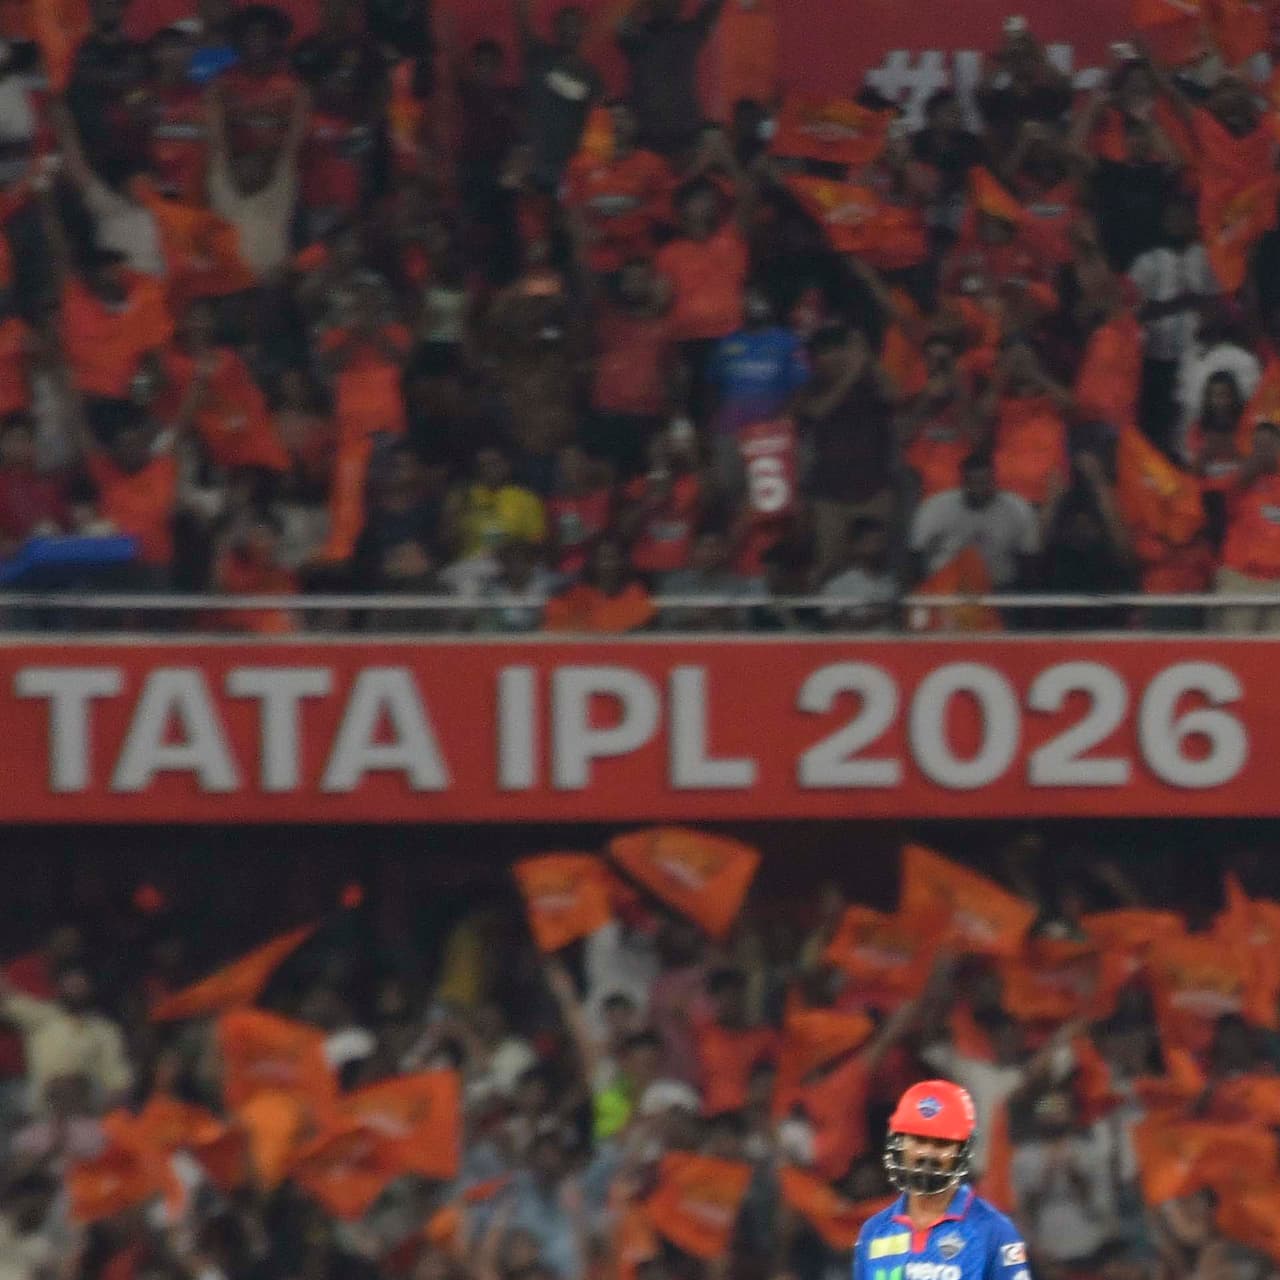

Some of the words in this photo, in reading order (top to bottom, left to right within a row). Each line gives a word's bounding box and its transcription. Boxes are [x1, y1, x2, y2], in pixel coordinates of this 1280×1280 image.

[14, 664, 452, 793] TATA
[498, 664, 757, 793] IPL
[797, 660, 1251, 792] 2026
